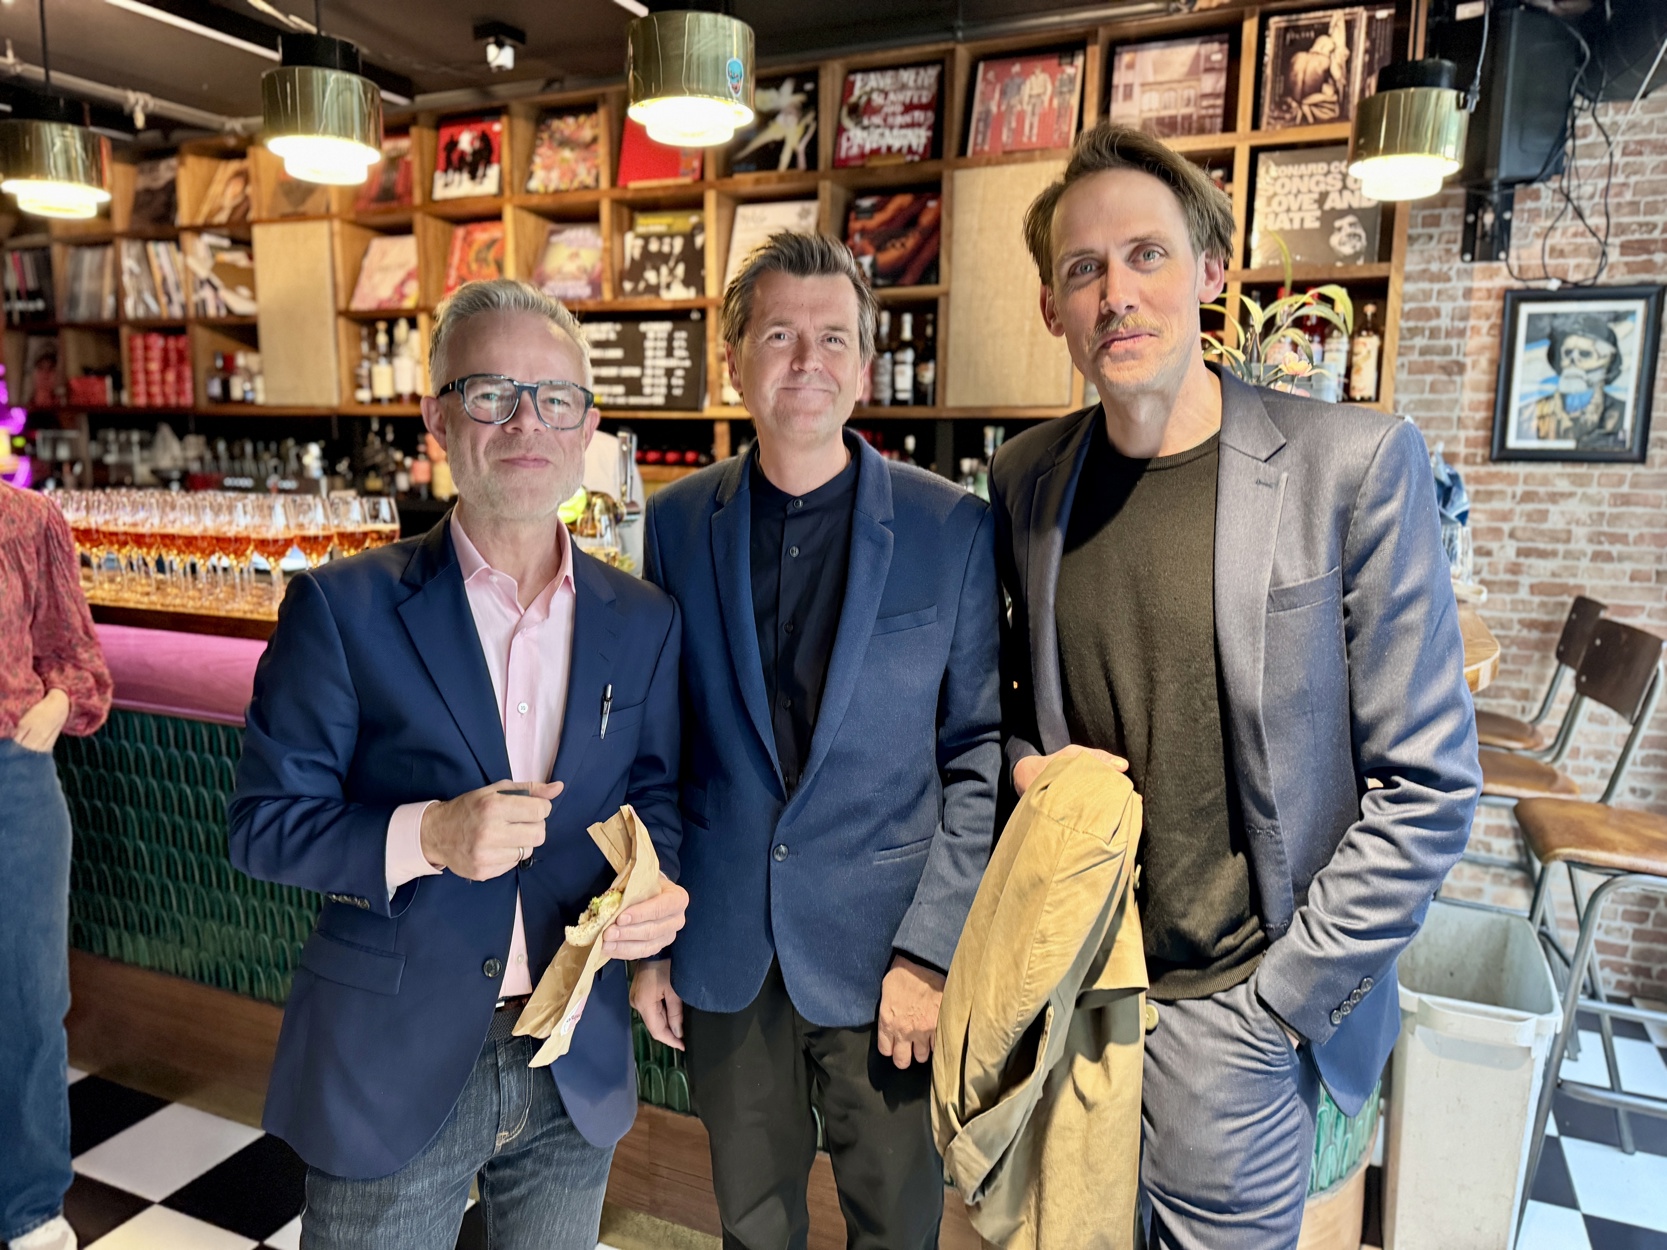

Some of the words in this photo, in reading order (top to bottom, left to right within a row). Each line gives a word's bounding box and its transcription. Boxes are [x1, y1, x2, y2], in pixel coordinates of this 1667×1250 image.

[1330, 159, 1349, 174] CO
[1257, 173, 1343, 196] SONGS
[1346, 176, 1362, 191] O
[1254, 193, 1320, 213] LOVE
[1323, 189, 1379, 210] AND
[1255, 210, 1321, 231] HATE
